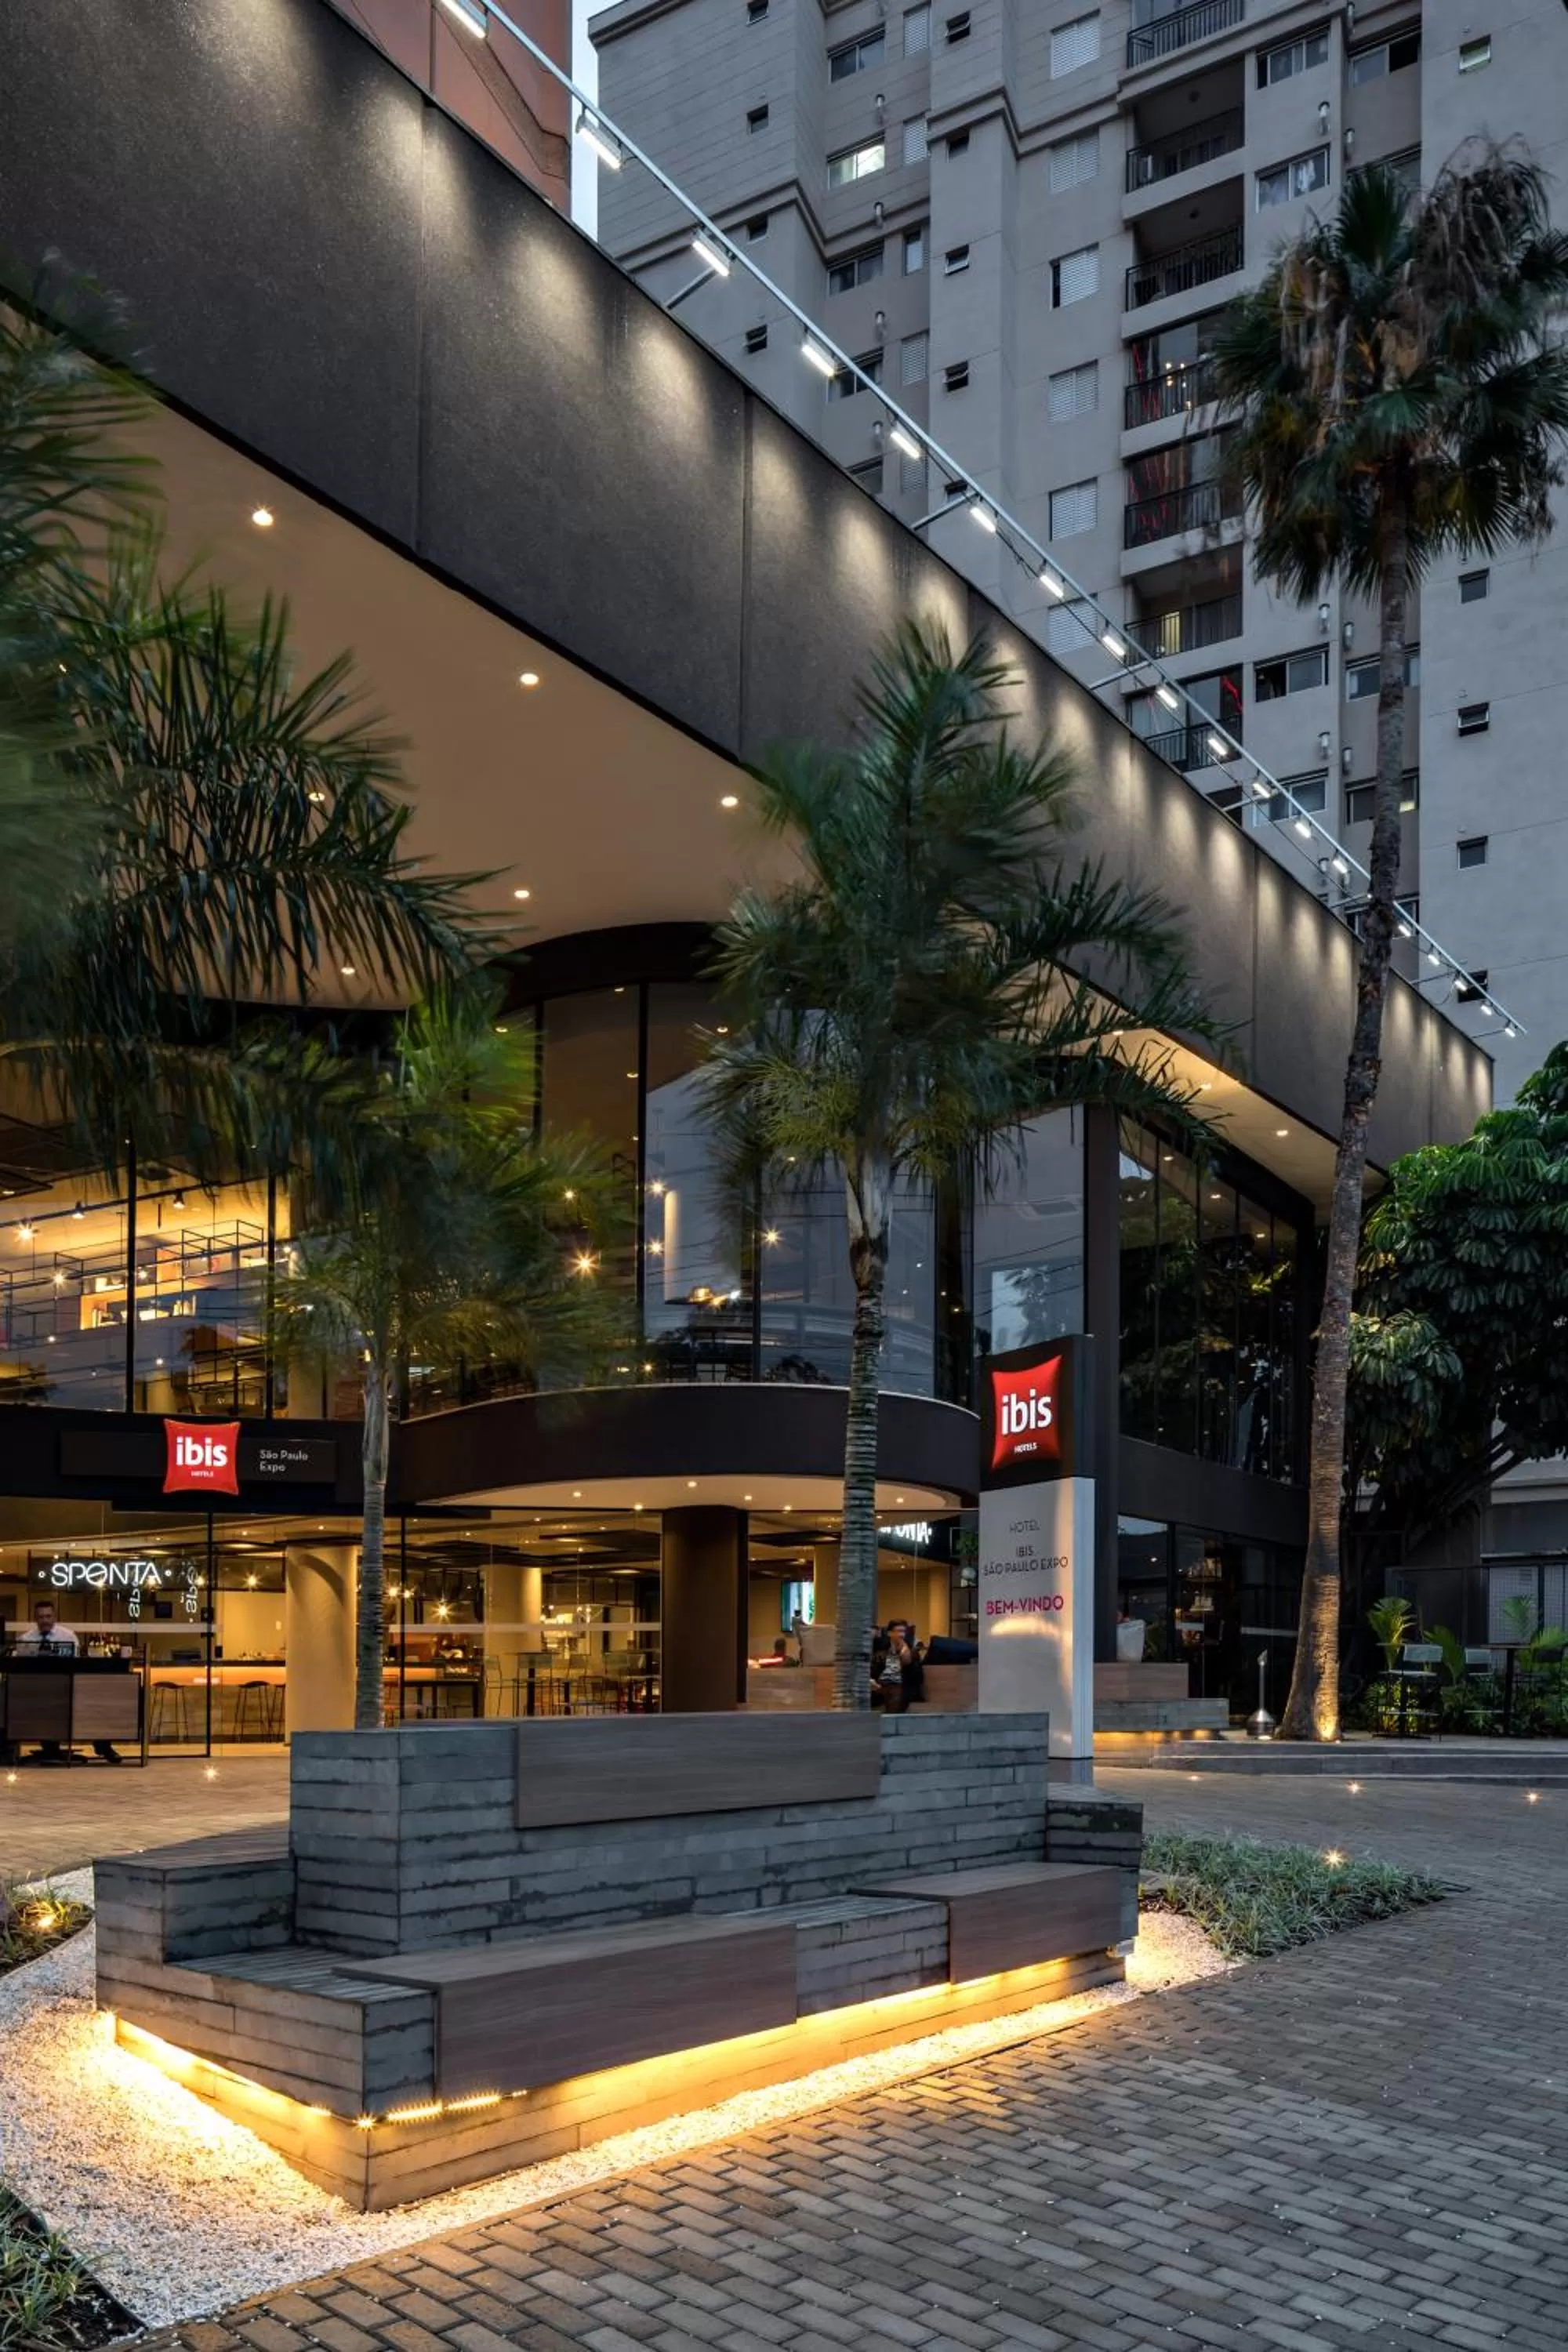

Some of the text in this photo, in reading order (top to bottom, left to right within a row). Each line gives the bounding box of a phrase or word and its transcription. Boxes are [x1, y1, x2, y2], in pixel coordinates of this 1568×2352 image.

[1001, 1388, 1052, 1436] ibis
[176, 1436, 228, 1467] ibis
[260, 1449, 308, 1461] São Paulo
[1014, 1442, 1037, 1454] HOTELS
[260, 1461, 286, 1473] Expo
[1009, 1519, 1040, 1534] HOTEL
[1016, 1545, 1034, 1557] IBIS
[1004, 1558, 1039, 1573] PAULO
[1040, 1556, 1068, 1570] EXPO
[985, 1595, 1064, 1616] BEM-VINDO
